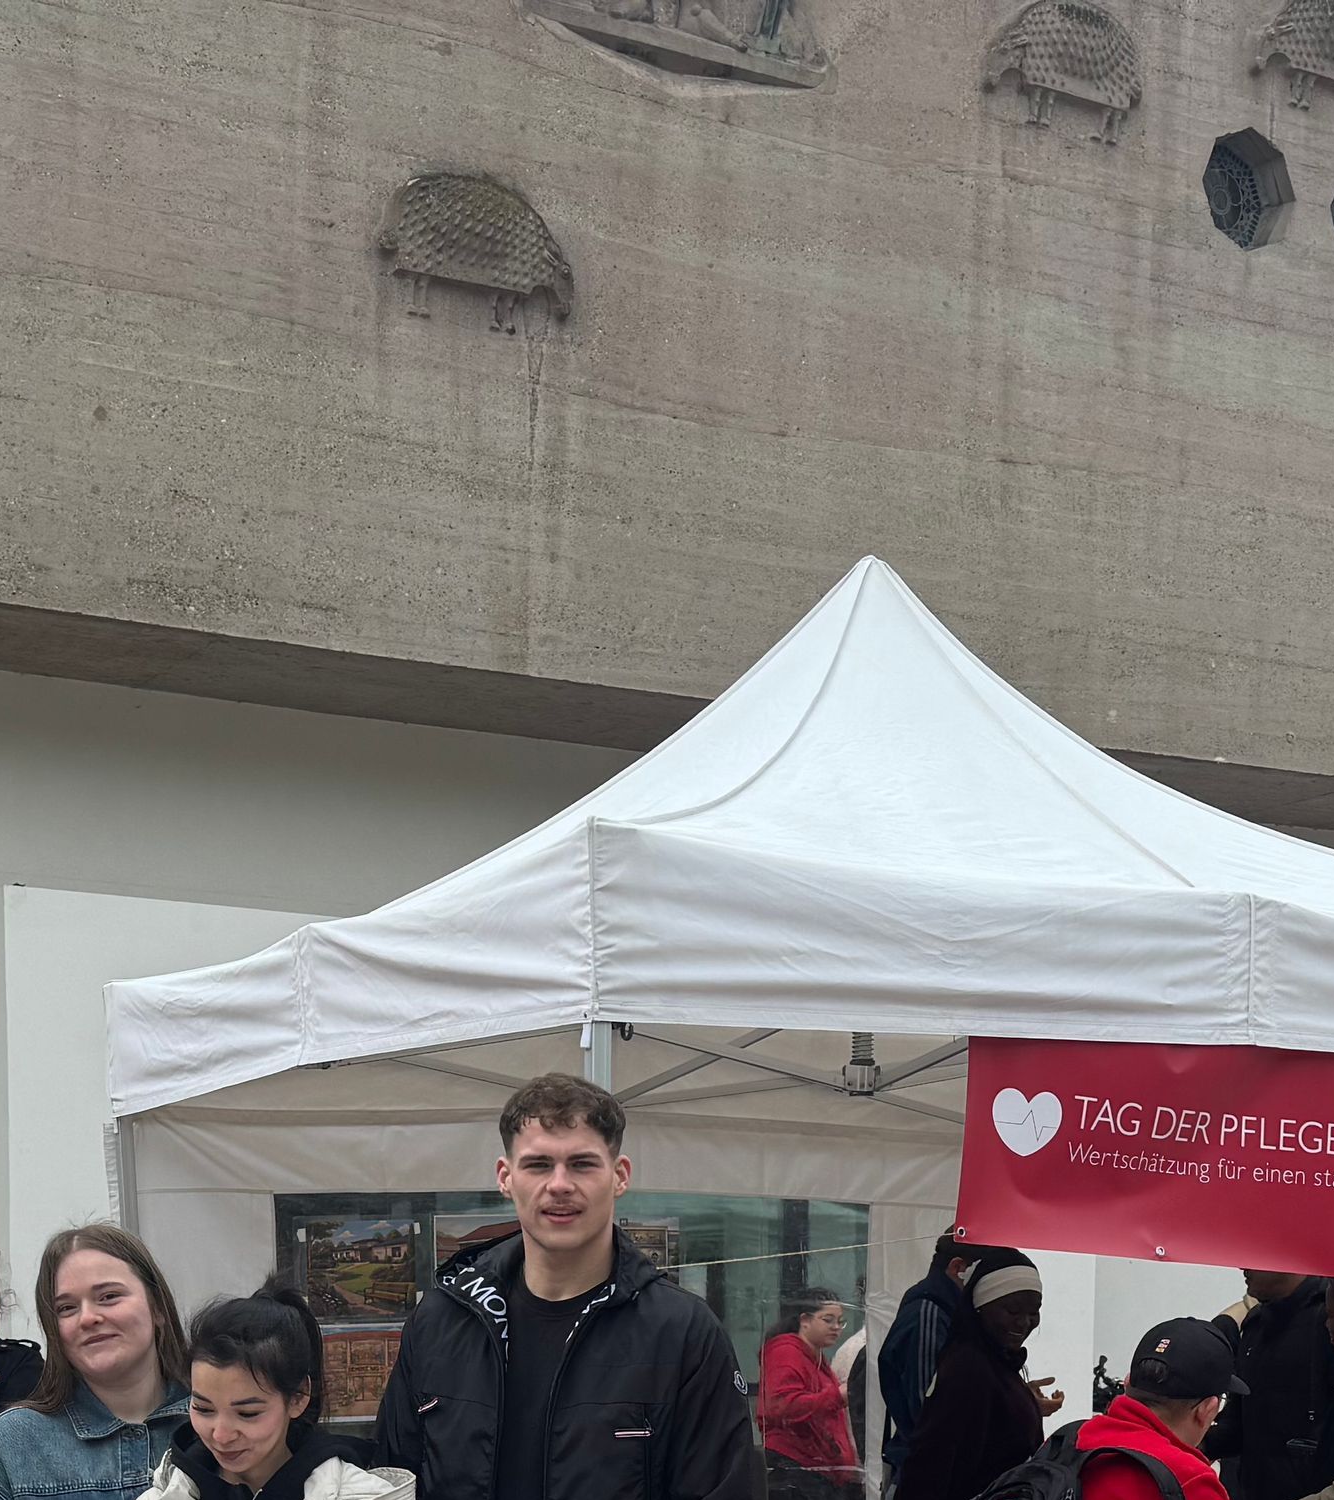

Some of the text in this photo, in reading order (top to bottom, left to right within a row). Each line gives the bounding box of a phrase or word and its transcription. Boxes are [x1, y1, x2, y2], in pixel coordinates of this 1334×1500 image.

[1074, 1095, 1143, 1136] TAG
[1151, 1105, 1210, 1145] DER
[1068, 1141, 1210, 1184] Wertschätzung
[1217, 1158, 1247, 1180] für
[1252, 1162, 1306, 1186] einen
